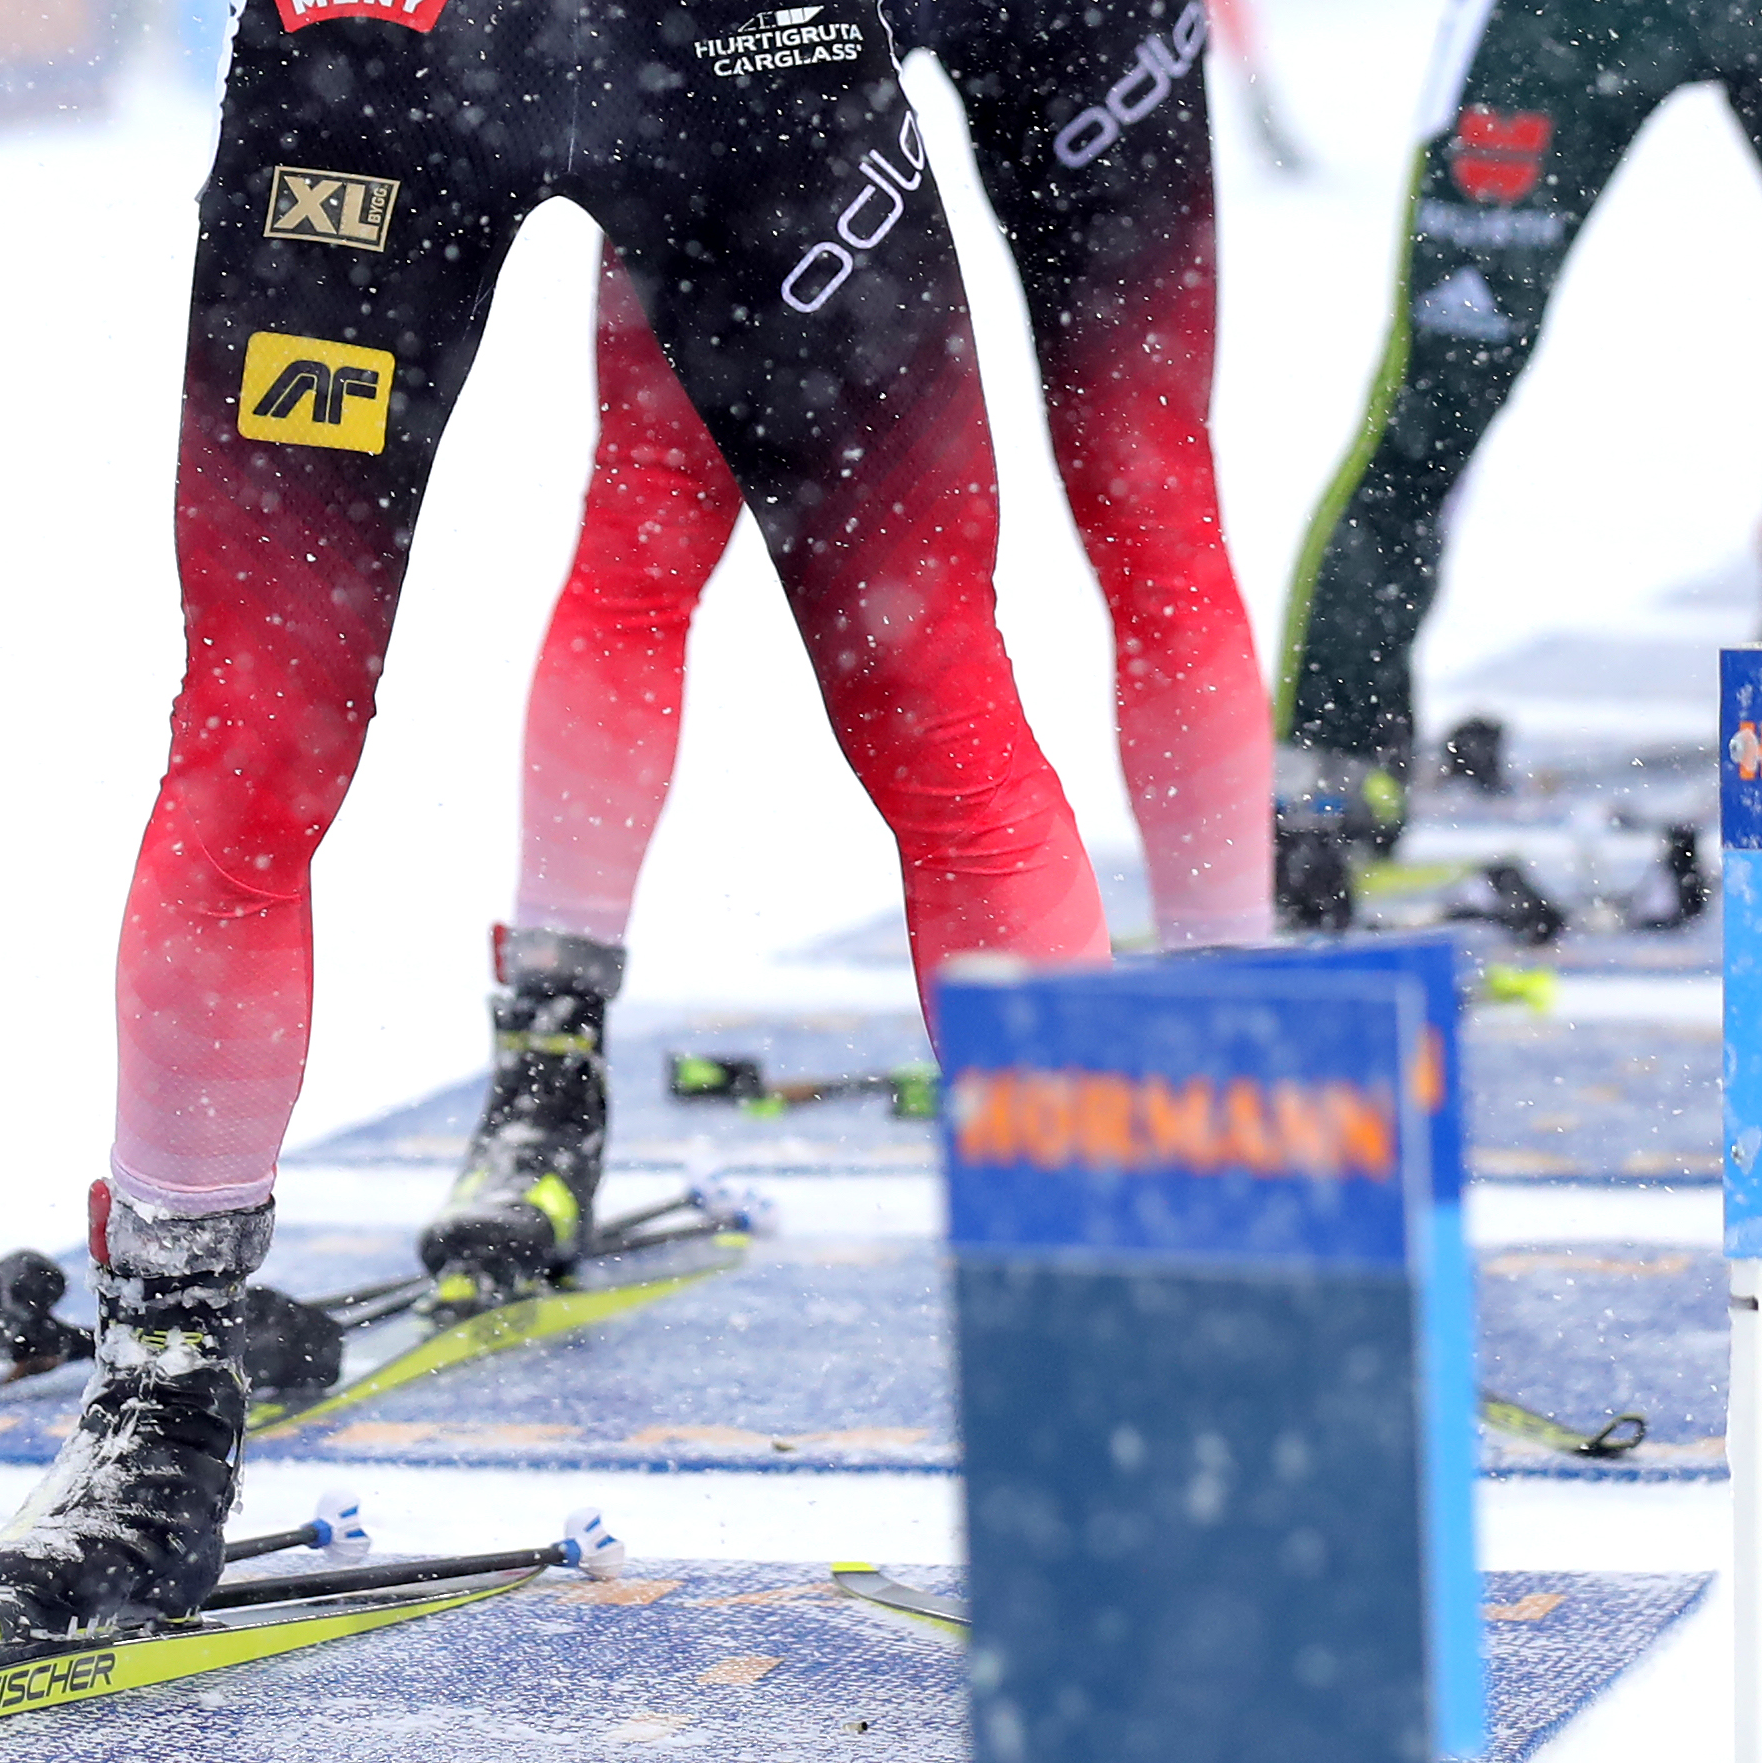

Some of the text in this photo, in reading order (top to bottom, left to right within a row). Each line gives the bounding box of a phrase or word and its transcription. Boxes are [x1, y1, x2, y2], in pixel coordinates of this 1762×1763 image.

[694, 23, 864, 59] HURTIGRUTA
[713, 43, 863, 77] CARGLASS
[1052, 0, 1208, 169] odlo
[273, 174, 380, 242] XL
